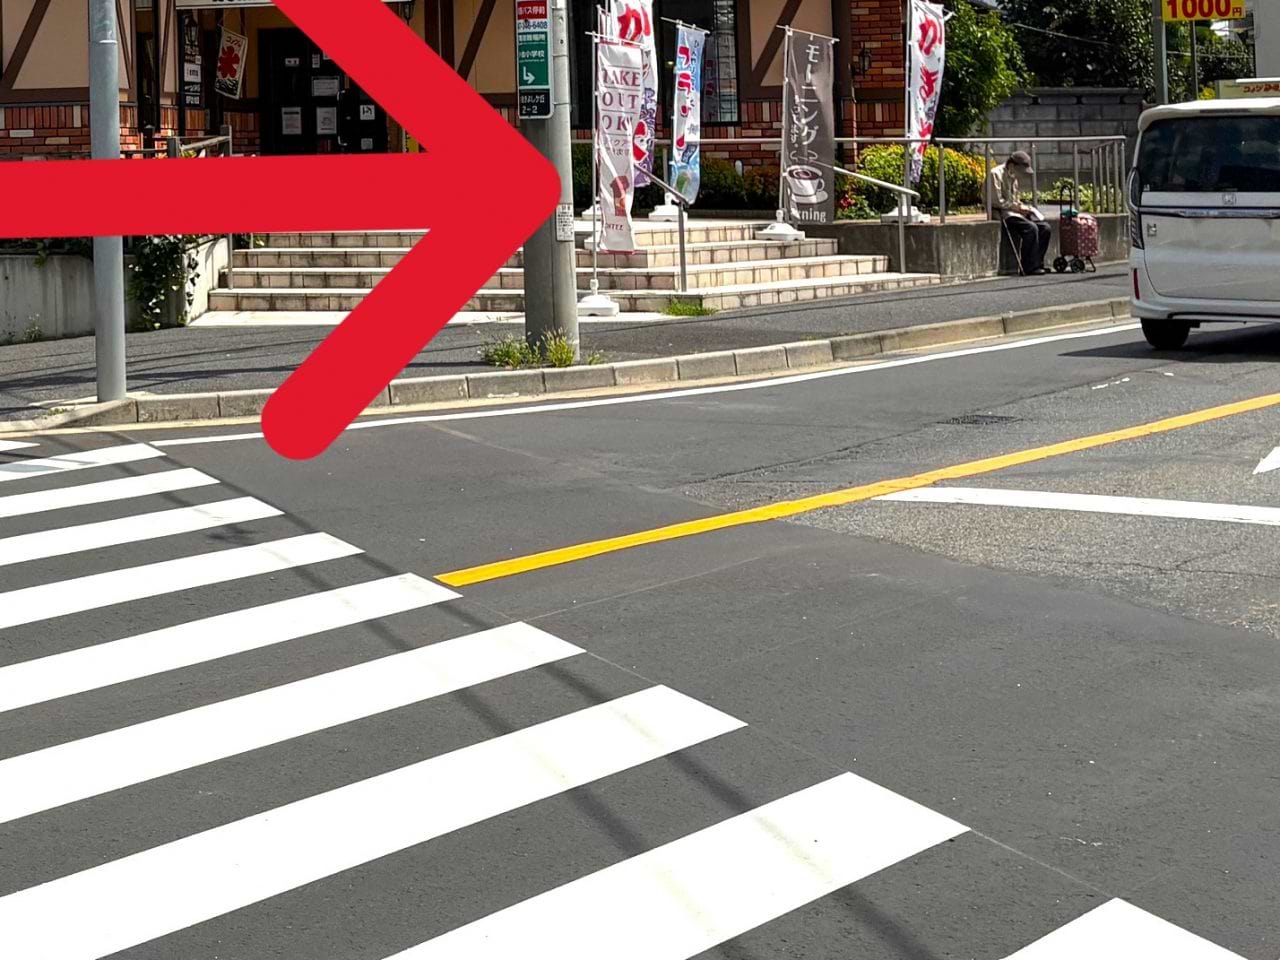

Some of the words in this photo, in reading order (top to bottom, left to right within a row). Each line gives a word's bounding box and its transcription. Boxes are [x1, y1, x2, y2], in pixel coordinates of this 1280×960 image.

[603, 68, 641, 86] TAKE
[602, 91, 639, 109] OUT
[801, 44, 820, 145] モーニング
